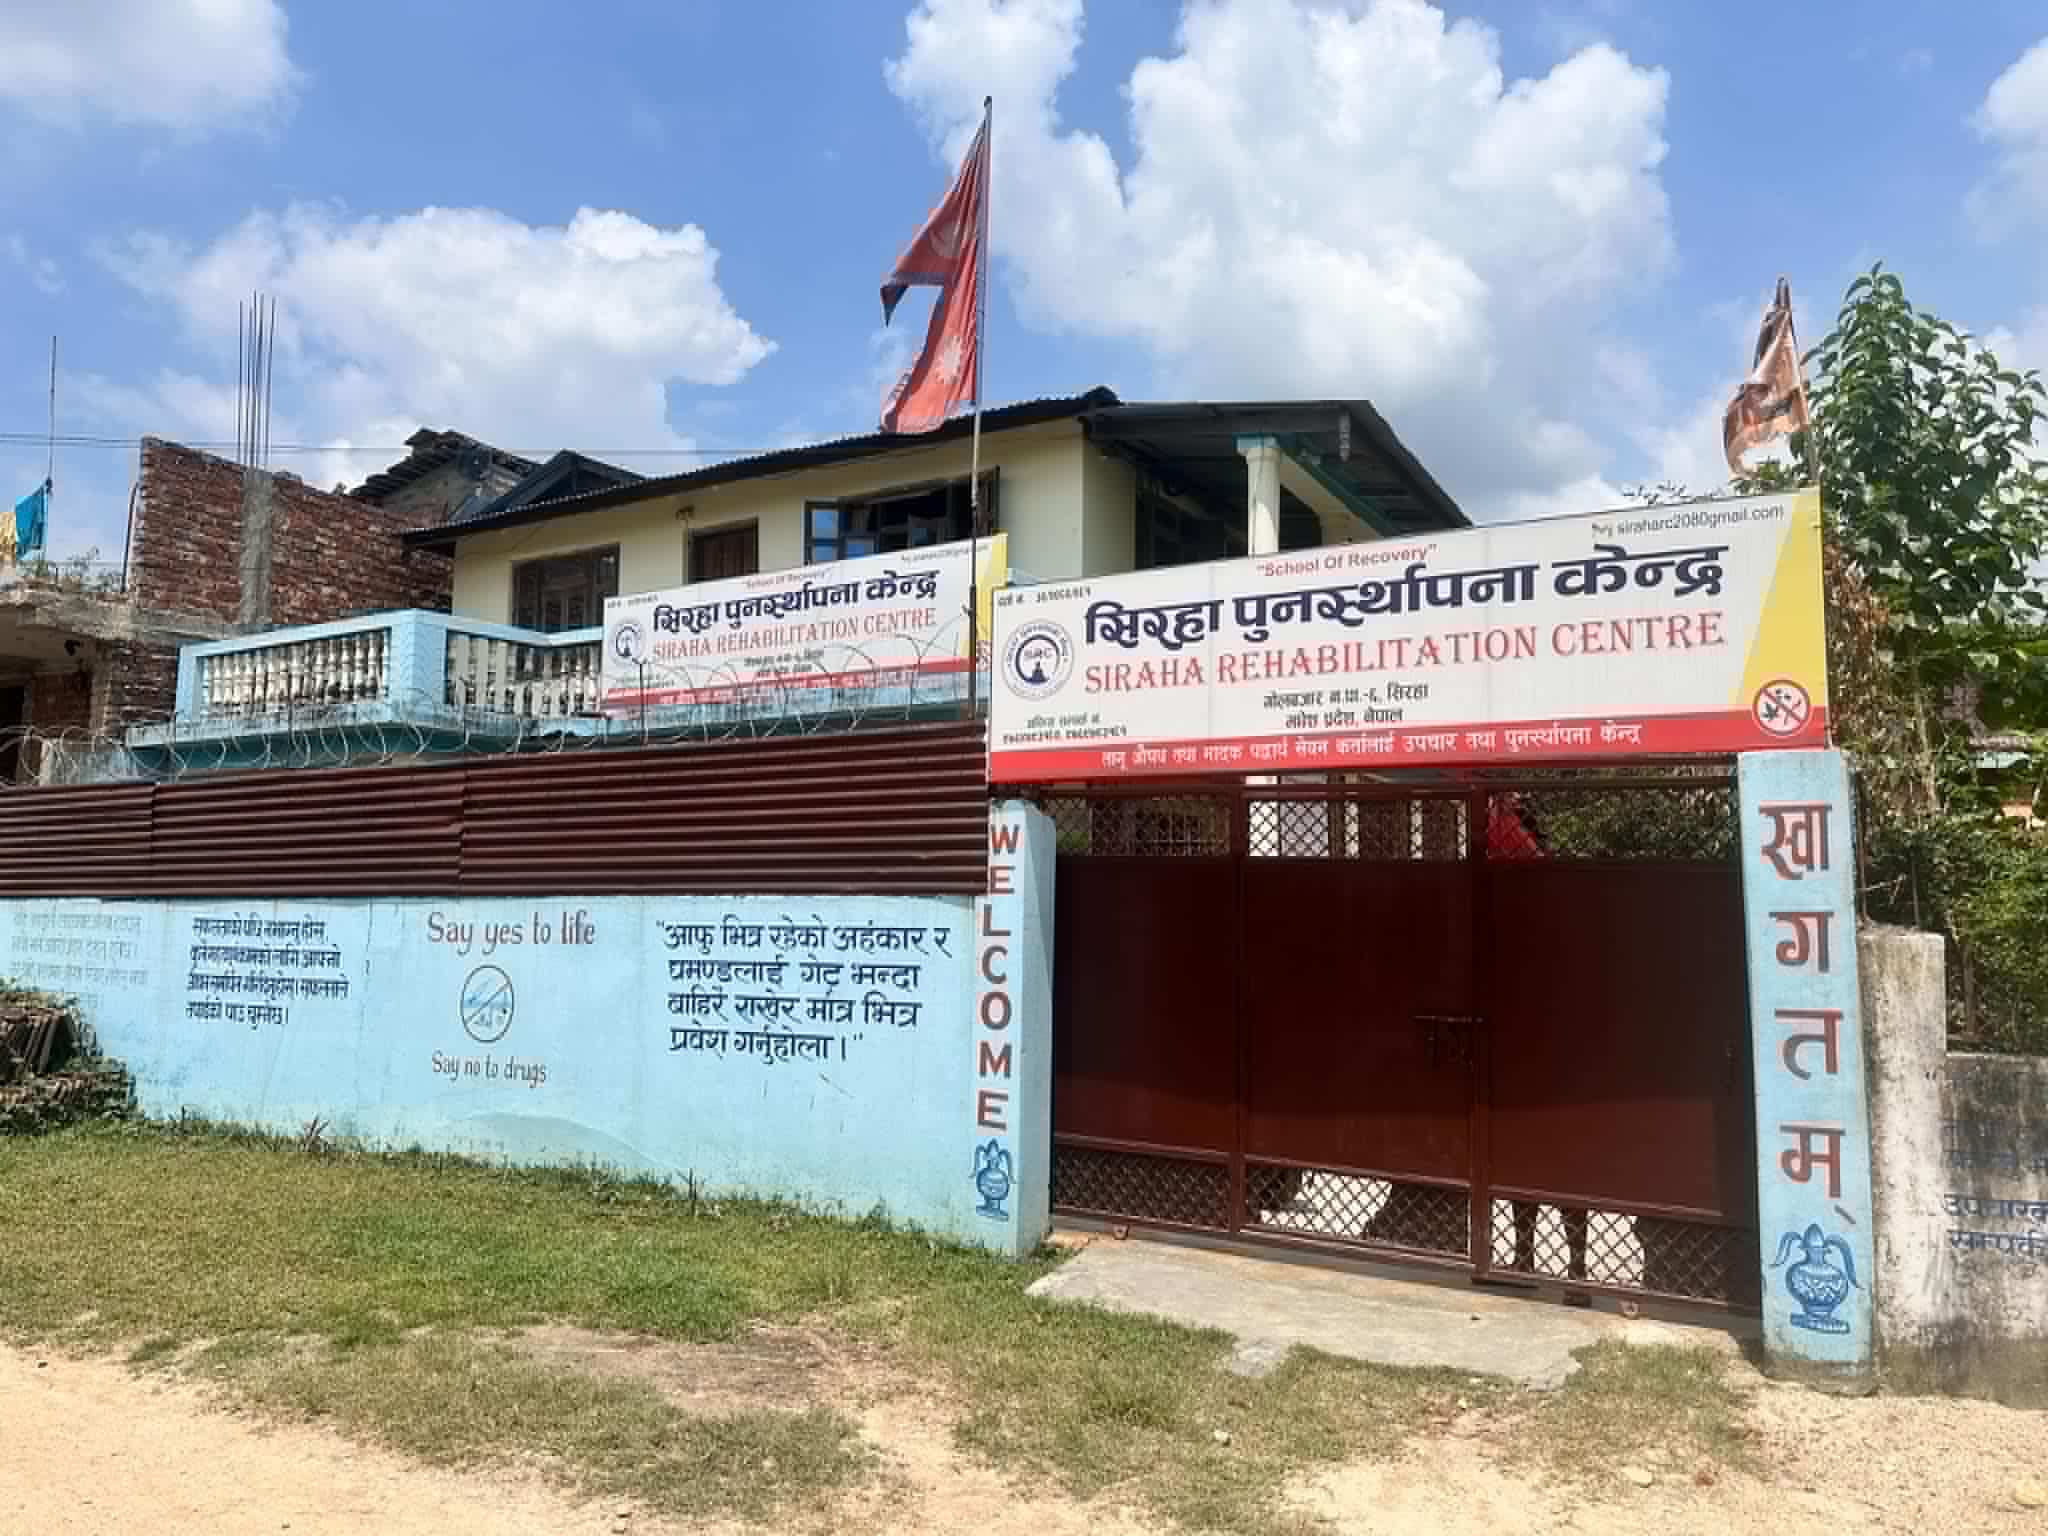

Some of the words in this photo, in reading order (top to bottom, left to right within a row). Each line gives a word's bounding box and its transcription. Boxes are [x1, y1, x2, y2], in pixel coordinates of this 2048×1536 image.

[1323, 556, 1345, 570] Of
[1085, 600, 1225, 650] सिरहा
[1551, 544, 1729, 597] केन्द्र
[653, 603, 720, 634] सिरहा
[654, 637, 712, 660] SIRAHA
[717, 620, 859, 655] REHABILITATION
[864, 607, 937, 636] CENTRE
[1084, 656, 1207, 695] SIRAHA
[1215, 624, 1538, 684] REHABILITATION
[1551, 611, 1727, 657] CENTRE
[428, 912, 475, 954] Say
[484, 919, 524, 957] yes
[532, 912, 552, 945] to
[560, 911, 596, 946] life
[721, 913, 764, 949] भित्र
[976, 823, 1020, 1131] WELCOME
[863, 992, 923, 1028] भित्र
[669, 1021, 728, 1060] प्रवेश
[431, 1050, 460, 1081] Say
[463, 1058, 481, 1076] no
[483, 1053, 499, 1076] to
[503, 1053, 547, 1085] drugs
